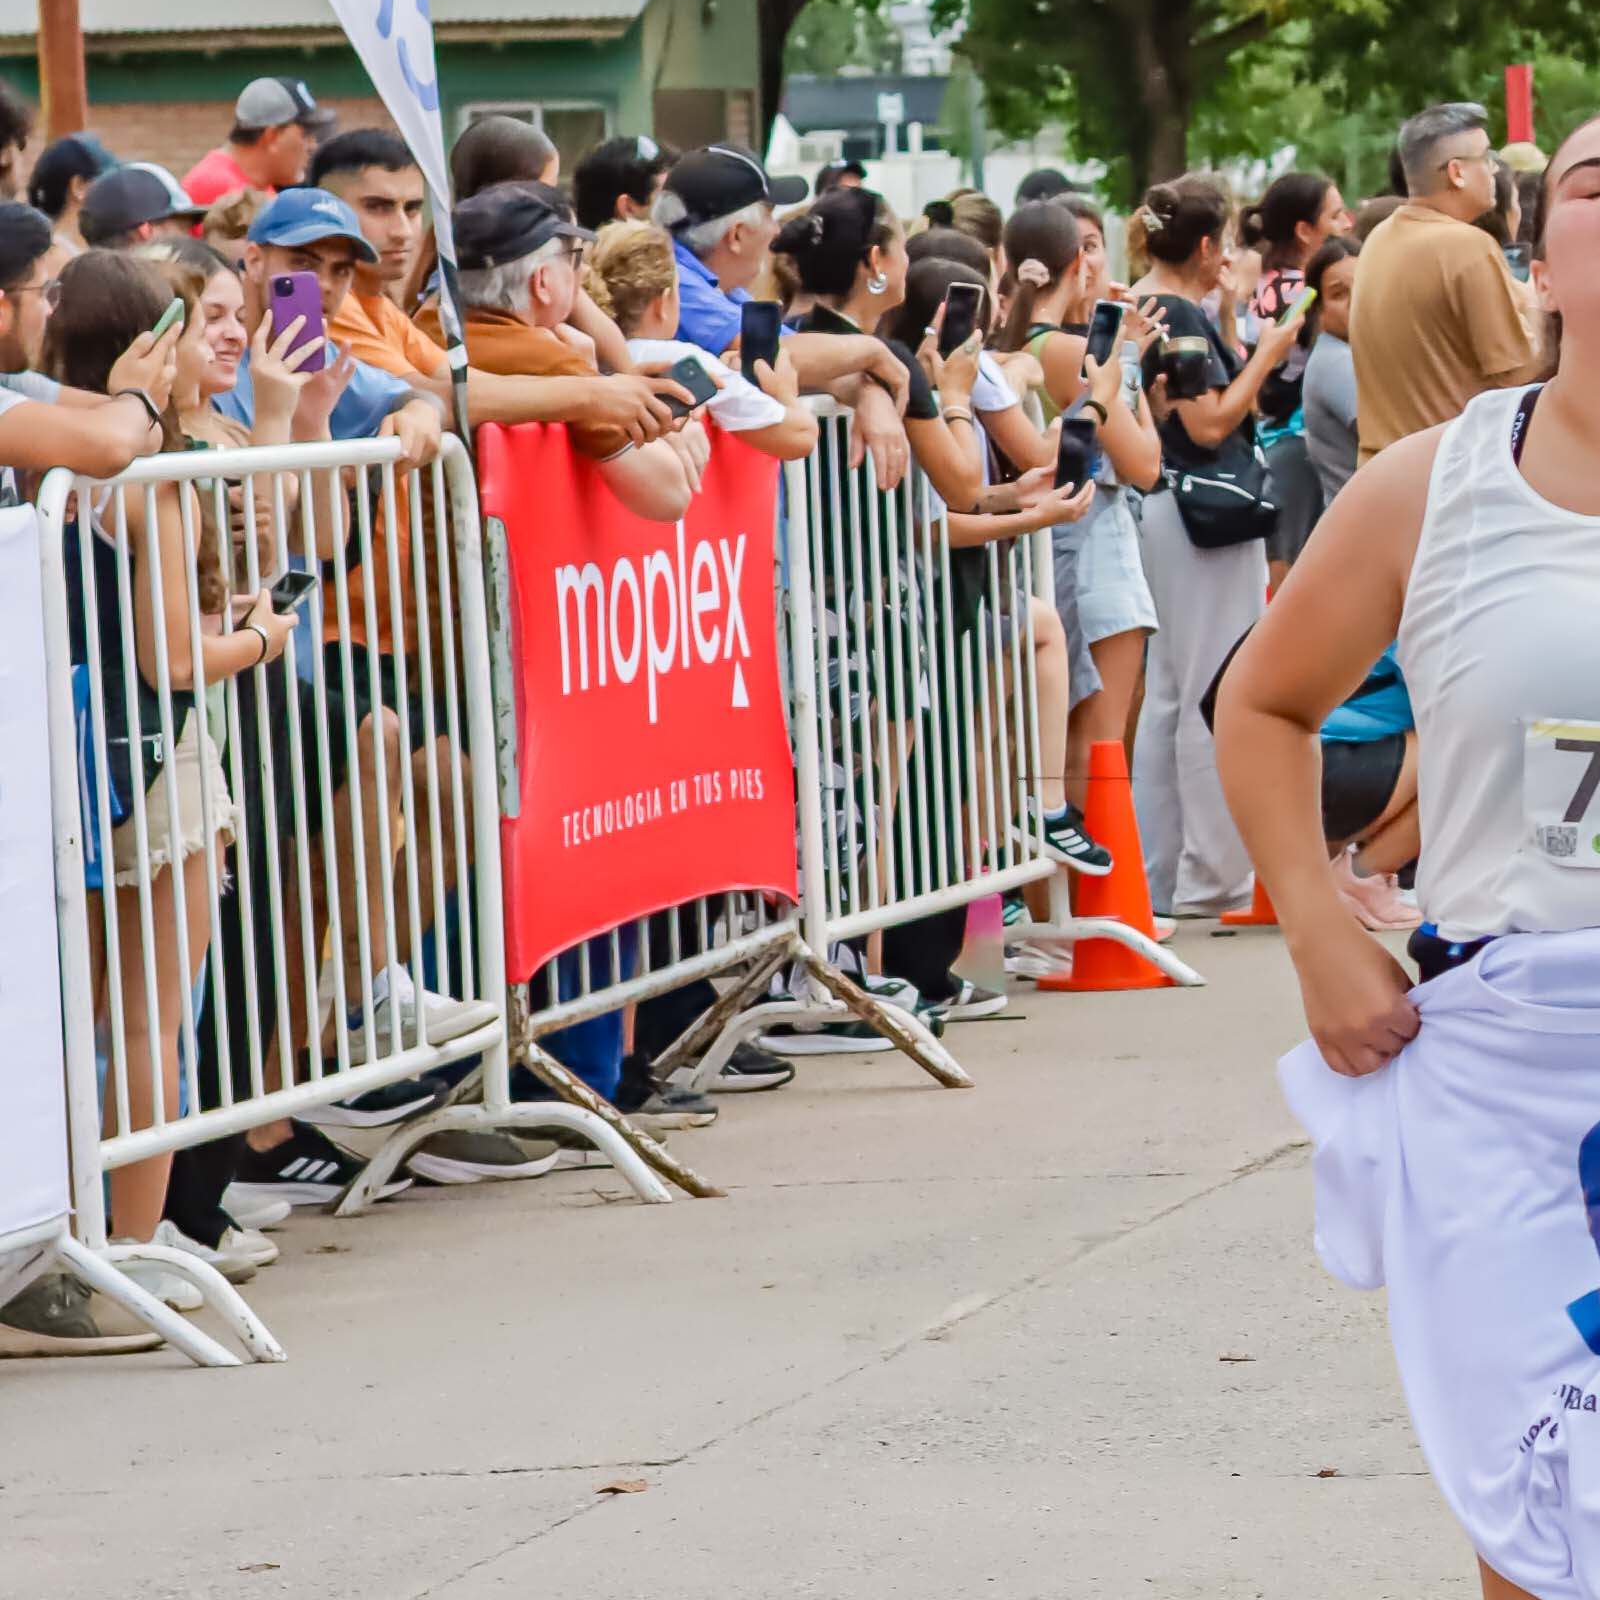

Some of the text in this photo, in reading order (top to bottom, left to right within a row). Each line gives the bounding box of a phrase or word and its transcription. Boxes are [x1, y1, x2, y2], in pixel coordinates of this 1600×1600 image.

[554, 520, 751, 724] moplex
[562, 767, 765, 848] TECNOLOGIA EN TUS PIES
